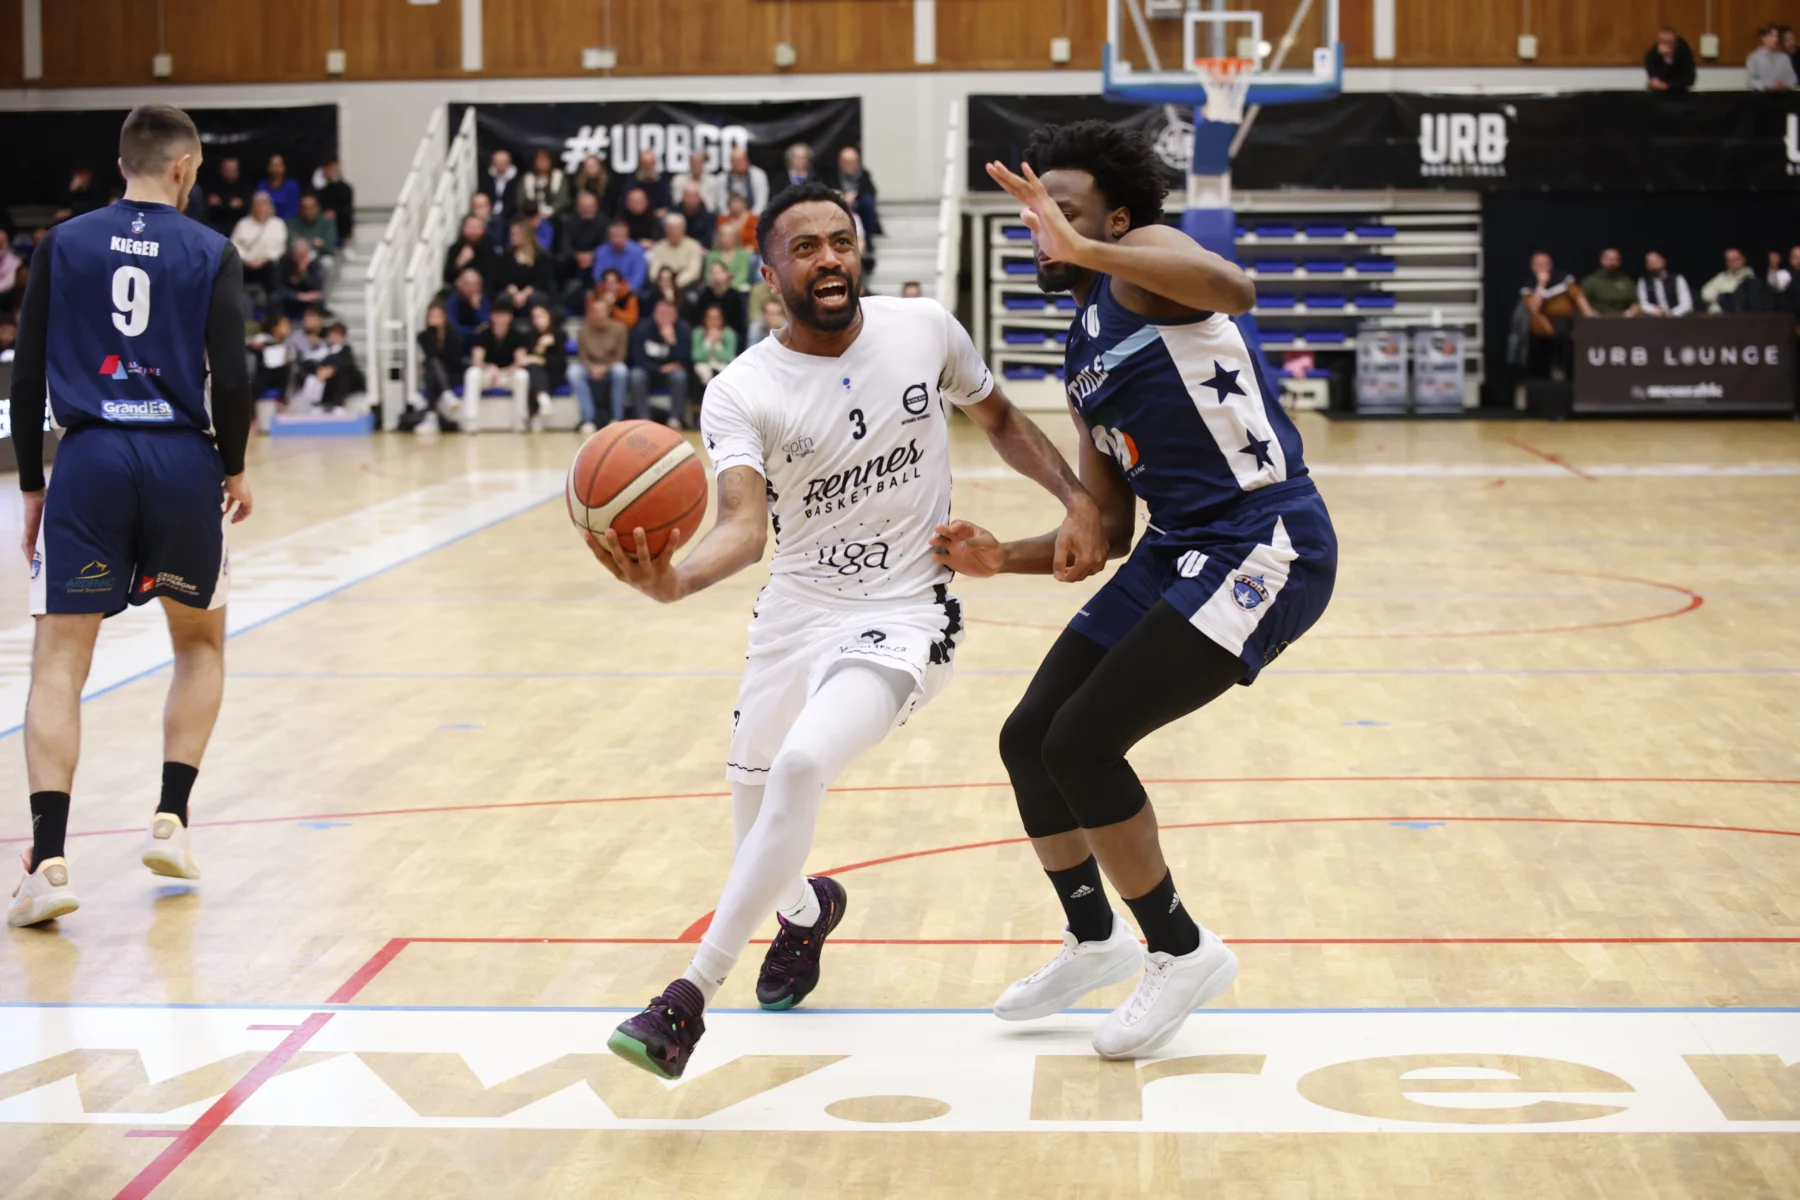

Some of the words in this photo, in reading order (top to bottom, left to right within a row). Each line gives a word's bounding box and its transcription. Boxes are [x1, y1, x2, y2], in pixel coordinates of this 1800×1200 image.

[1418, 112, 1509, 164] URB
[110, 235, 160, 257] KIEGER
[111, 265, 151, 337] 9
[1587, 346, 1649, 366] URB
[1663, 345, 1780, 366] LOUNGE
[1068, 354, 1110, 414] TOILE
[849, 408, 867, 440] 3
[802, 438, 924, 507] Rennes
[804, 466, 921, 518] BASKETBALL
